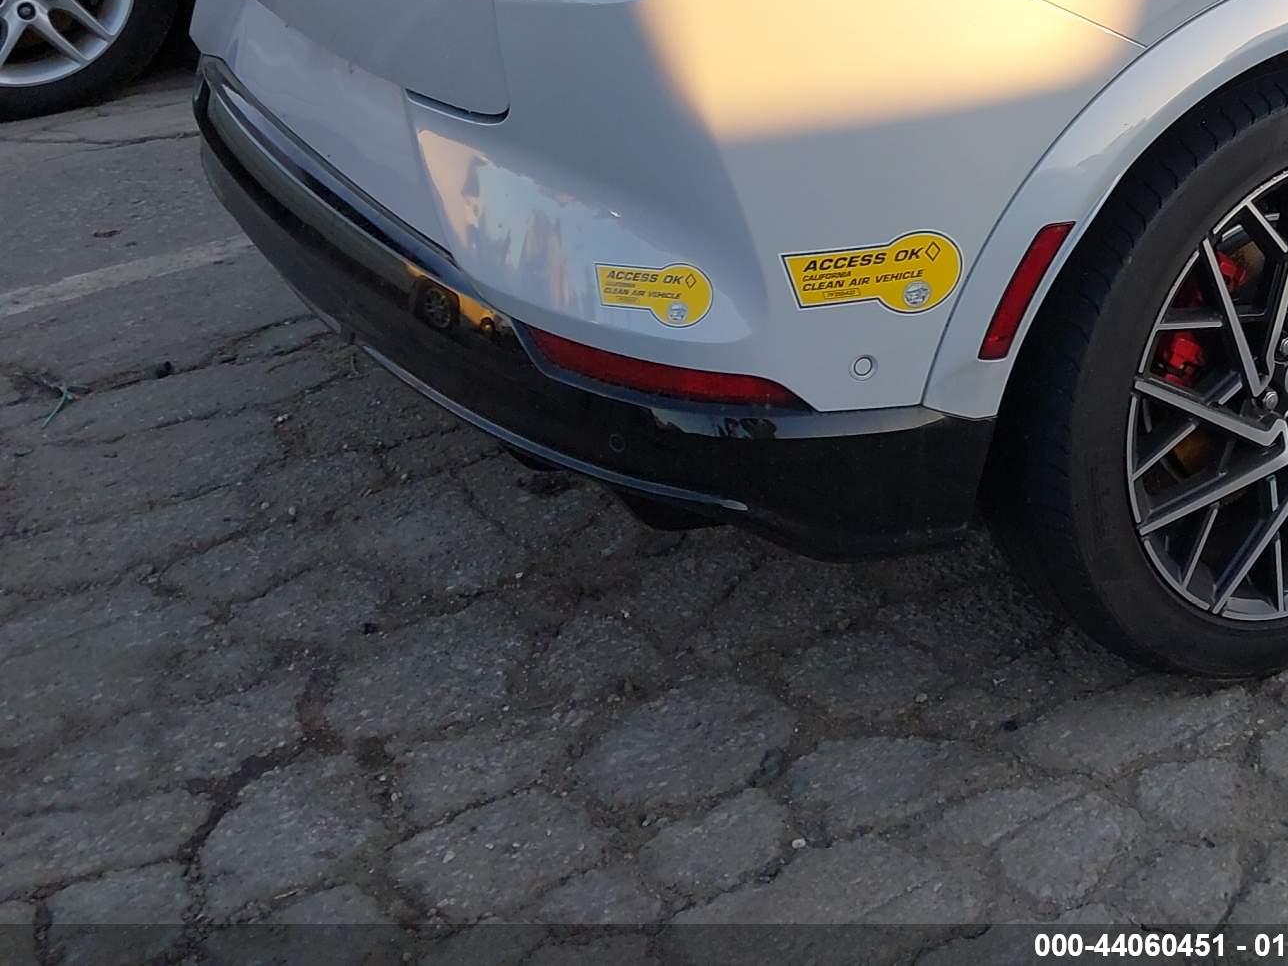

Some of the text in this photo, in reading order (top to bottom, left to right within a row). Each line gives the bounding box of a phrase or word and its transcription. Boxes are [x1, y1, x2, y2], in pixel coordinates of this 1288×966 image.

[803, 247, 923, 274] ACCESS OK
[607, 270, 684, 285] ACCESS OK
[802, 270, 852, 283] CALIFORNIA
[802, 269, 925, 292] CLEAN AIR VEHICLE
[631, 289, 646, 298] AIR
[648, 290, 682, 300] VEHICLE
